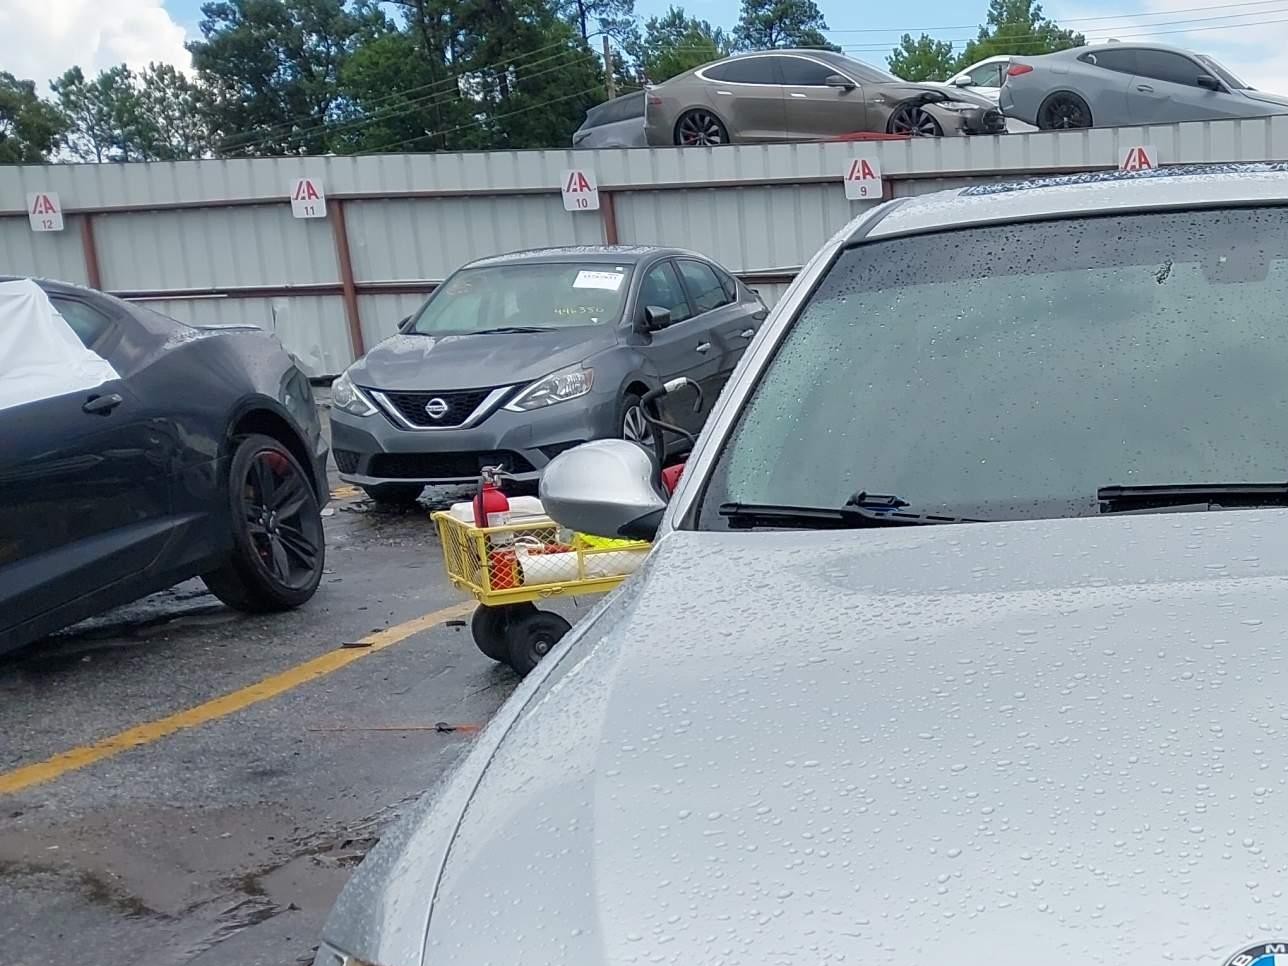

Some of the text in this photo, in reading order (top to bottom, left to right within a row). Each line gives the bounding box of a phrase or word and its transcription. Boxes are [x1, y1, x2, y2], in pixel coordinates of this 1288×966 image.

[860, 186, 867, 197] 9
[576, 198, 588, 208] 10
[304, 206, 315, 216] 11
[42, 219, 54, 229] 12
